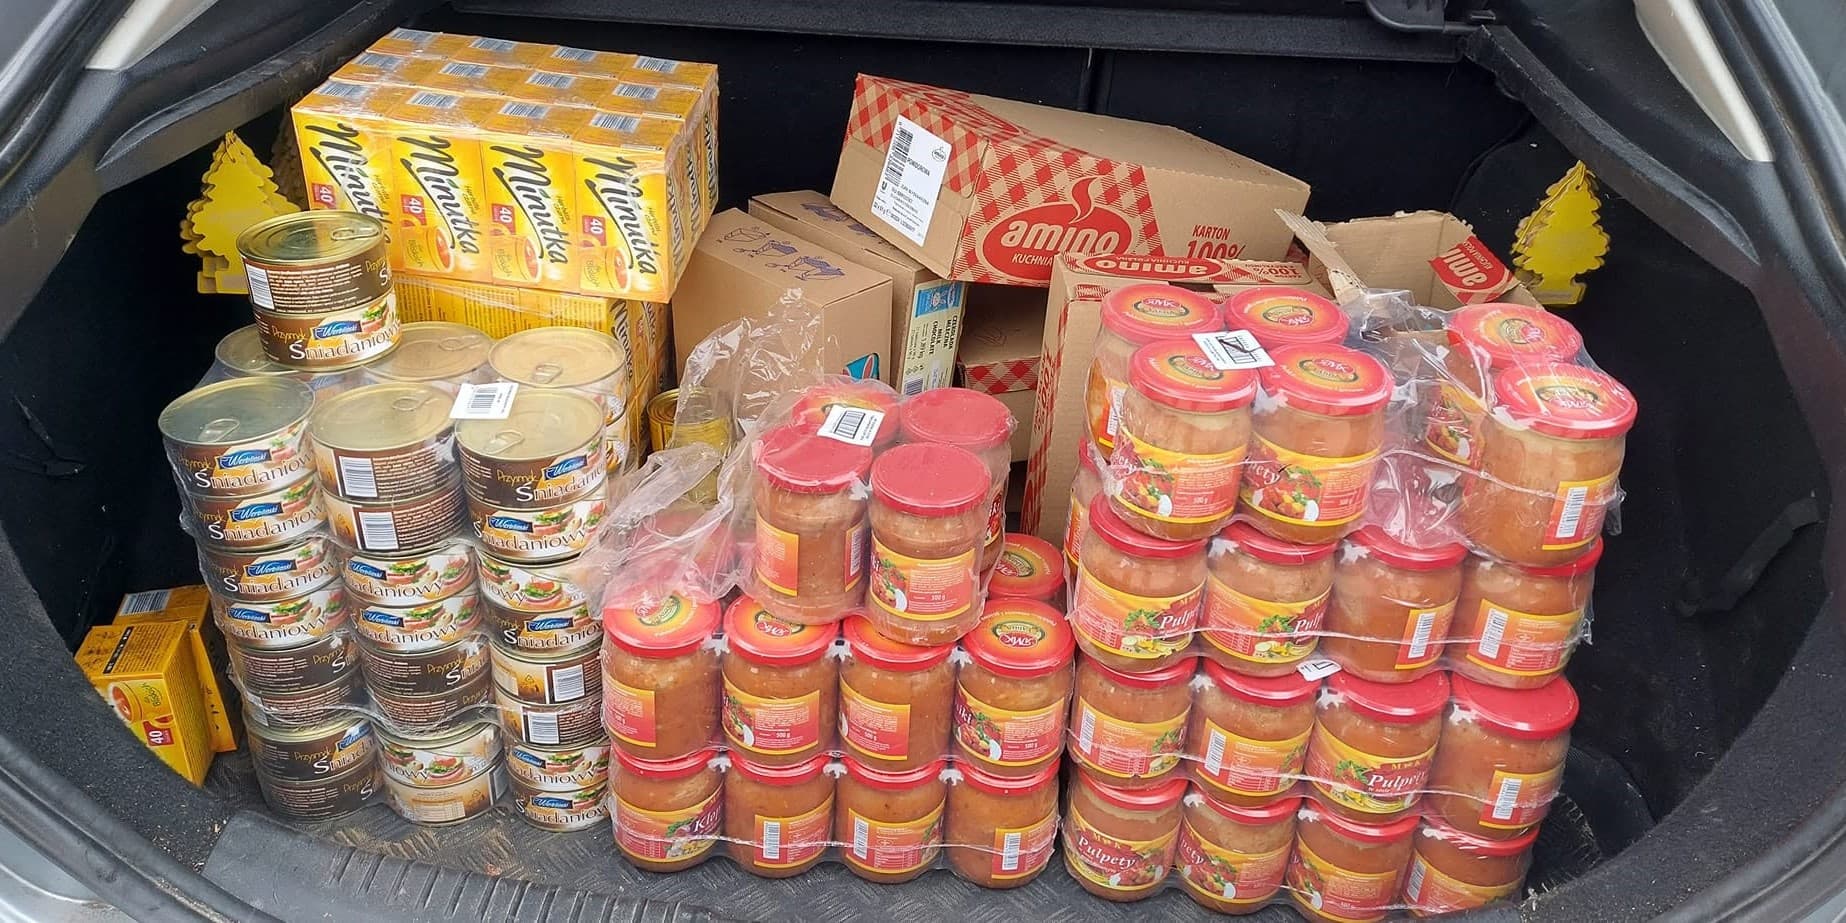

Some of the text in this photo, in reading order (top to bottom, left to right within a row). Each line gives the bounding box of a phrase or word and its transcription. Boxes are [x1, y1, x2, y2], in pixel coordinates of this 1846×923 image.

[305, 123, 393, 243] Minut
[319, 186, 333, 205] 40
[397, 135, 481, 254] Minutka
[408, 198, 423, 214] 40
[490, 145, 572, 264] Minutka
[499, 207, 513, 223] 40
[583, 156, 658, 275] Minutka
[589, 218, 603, 235] 40
[1192, 224, 1231, 240] KARTON
[1001, 220, 1120, 255] amino
[1012, 253, 1053, 266] KUCHNIA
[1095, 259, 1209, 275] amino
[150, 730, 165, 745] 40
[1078, 835, 1136, 870] Pulpety
